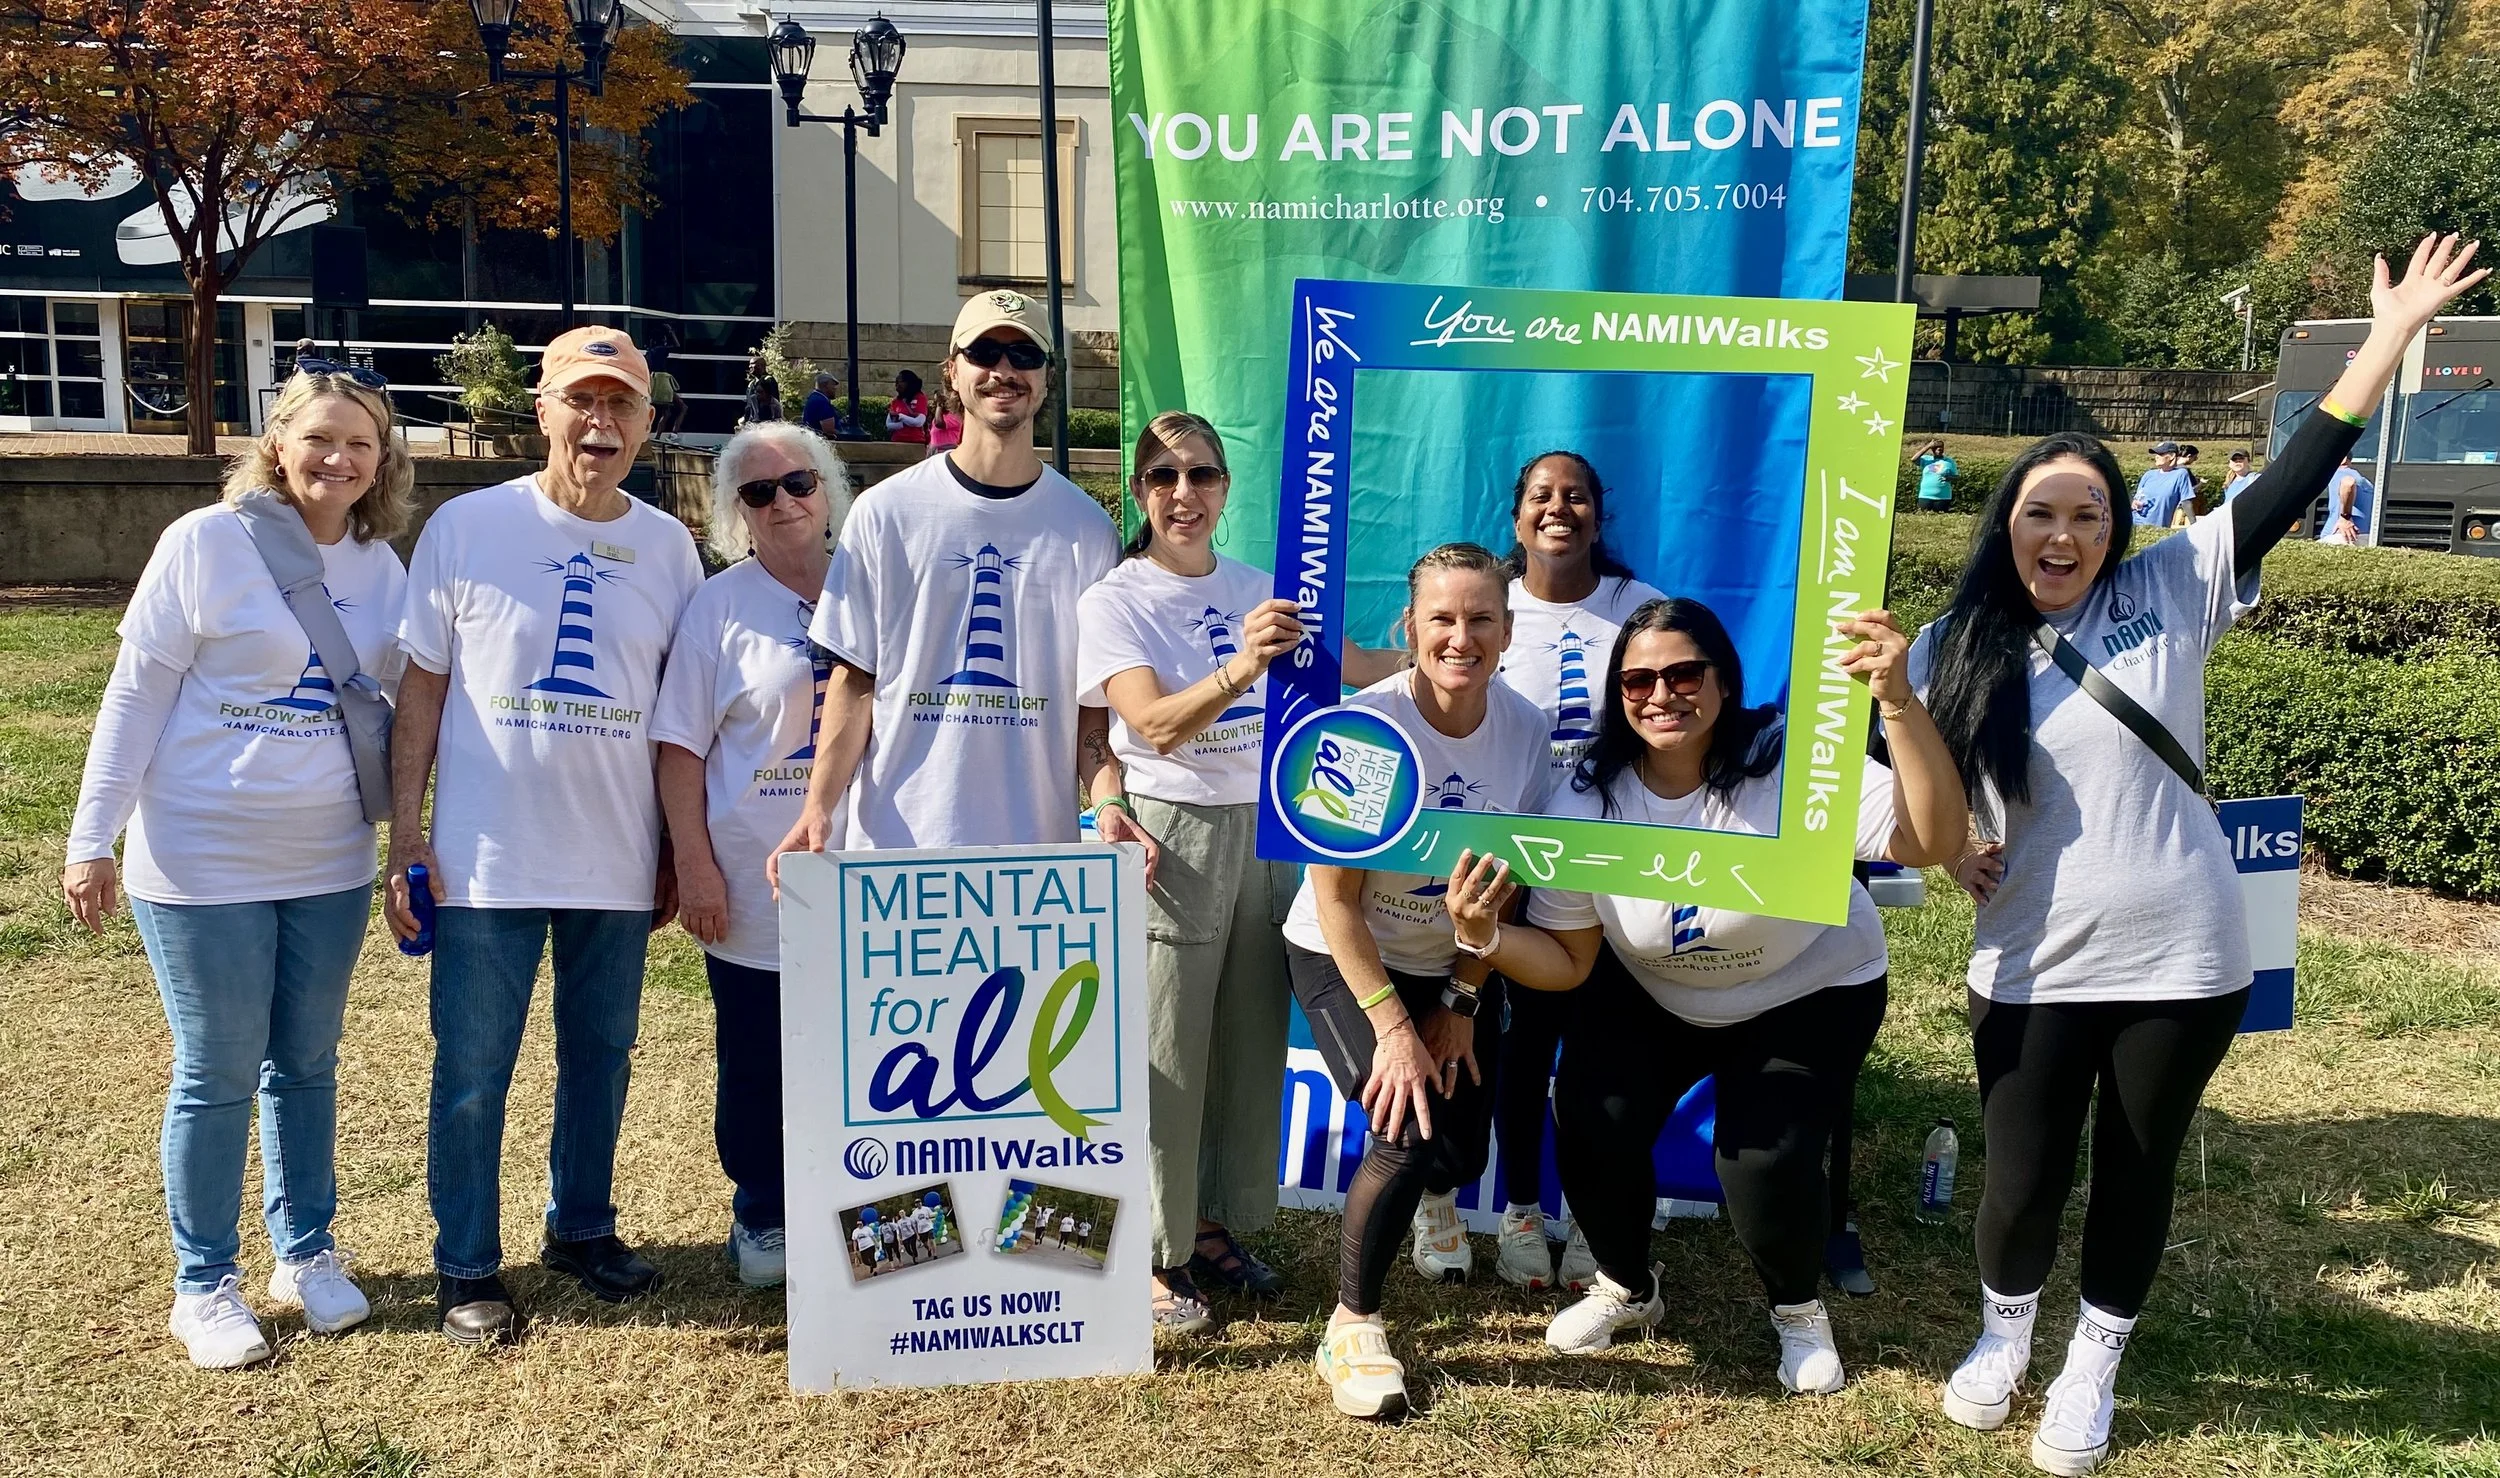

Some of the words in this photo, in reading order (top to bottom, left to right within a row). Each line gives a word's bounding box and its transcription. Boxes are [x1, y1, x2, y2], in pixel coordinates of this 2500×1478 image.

[1127, 111, 1258, 162] YOU
[1279, 112, 1413, 162] ARE
[1443, 104, 1584, 158] NOT
[1600, 96, 1844, 153] ALONE
[1169, 190, 1506, 225] www.namicharlotte.org
[1580, 183, 1788, 214] 704.705.7004
[1314, 306, 1362, 365] We
[1423, 294, 1515, 347] You
[1524, 316, 1582, 345] are
[1592, 311, 1830, 351] NAMIWalks
[2435, 366, 2468, 376] LOVE
[2473, 366, 2482, 375] U
[1307, 377, 1338, 444] are
[1839, 476, 1887, 519] I
[1293, 451, 1335, 669] NAMIWalks
[1826, 517, 1860, 583] am
[219, 702, 296, 723] FOLLOW
[490, 695, 559, 714] FOLLOW
[563, 701, 598, 718] THE
[601, 706, 643, 724] LIGHT
[908, 692, 971, 706] FOLLOW
[976, 694, 1005, 708] THE
[1009, 696, 1049, 711] LIGHT
[913, 713, 1039, 727] NAMICHARLOTTE.ORG
[223, 721, 348, 738] NAMICHARLOTTE.O
[496, 717, 632, 740] NAMICHARLOTTE.ORG
[1194, 739, 1262, 756] NAMICHARLOT
[1240, 721, 1264, 737] THE
[1341, 745, 1361, 772] for
[1292, 739, 1356, 821] all
[1348, 749, 1380, 824] HEALTH
[1363, 754, 1397, 829] MENTAL
[861, 866, 1107, 923] MENTAL
[1373, 891, 1432, 914] FOLLOW
[862, 922, 1097, 979] HEALTH
[1689, 954, 1718, 964] THE
[1722, 946, 1765, 962] LIGHT
[868, 987, 950, 1037] for
[867, 960, 1113, 1143] all
[1922, 1162, 1936, 1205] ALKALINE
[912, 1297, 954, 1321] TAG
[963, 1294, 992, 1317] US
[1000, 1290, 1061, 1315] NOW!
[889, 1320, 1085, 1356] #NAMIWALKSCLT
